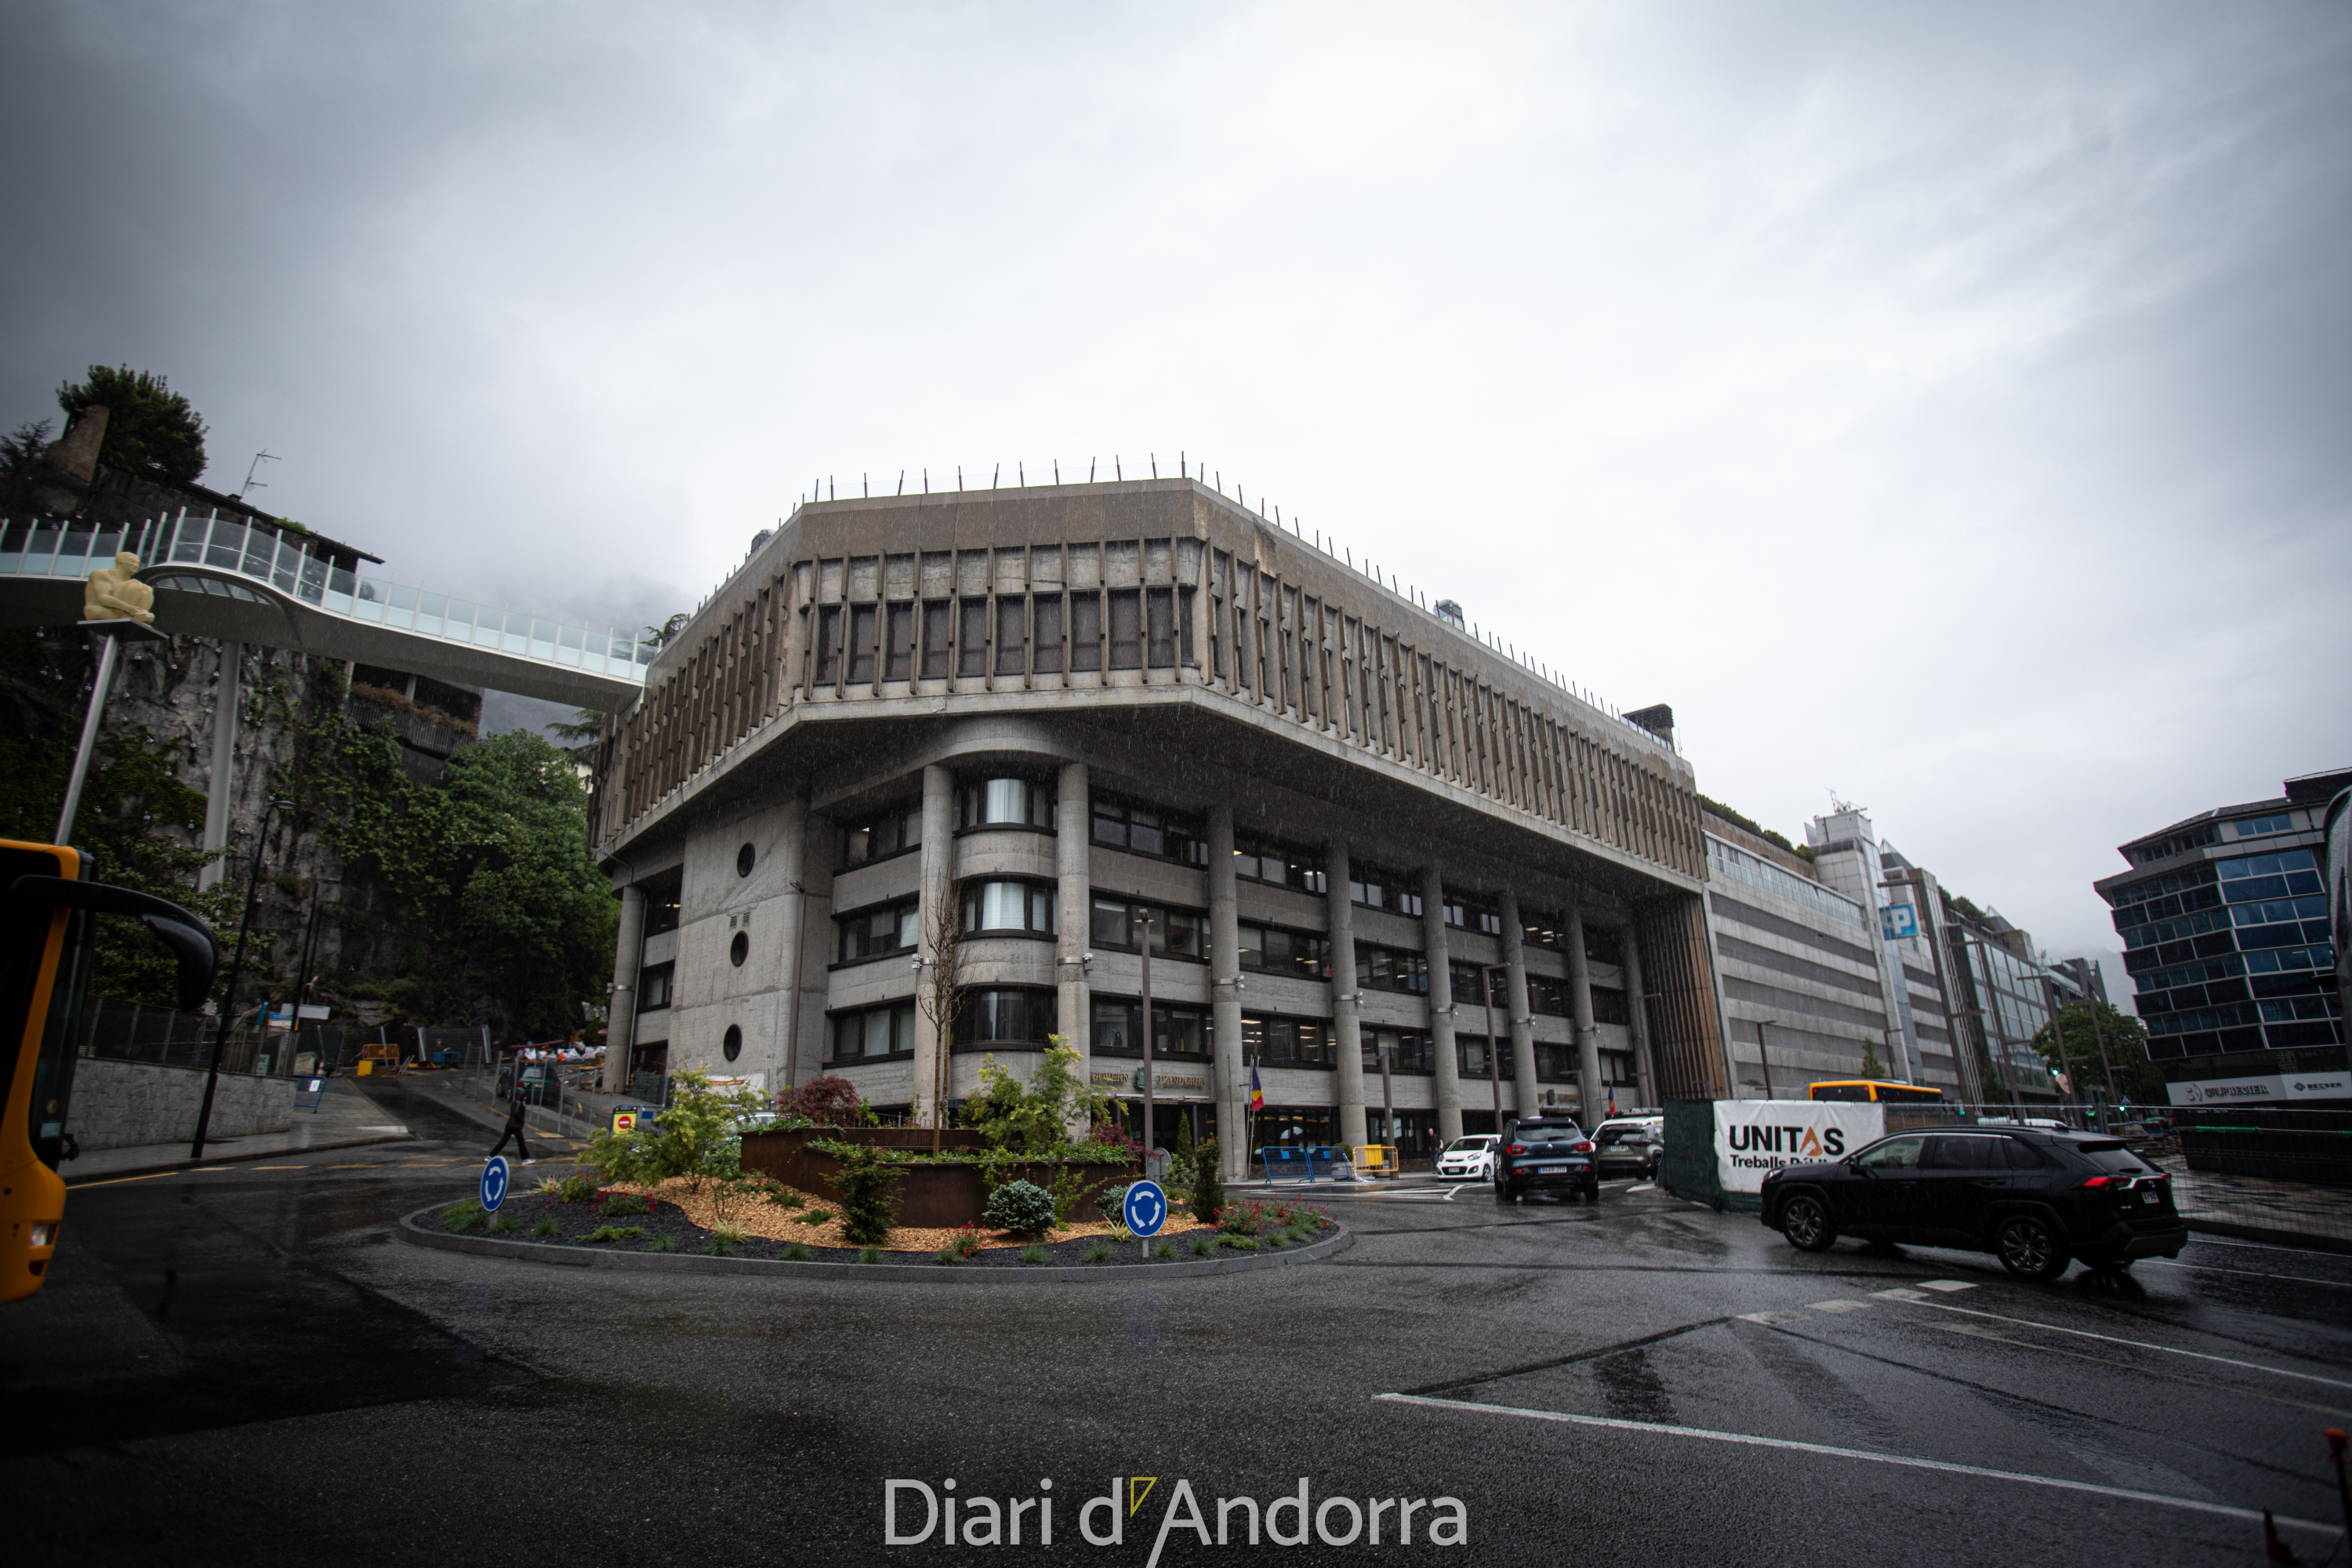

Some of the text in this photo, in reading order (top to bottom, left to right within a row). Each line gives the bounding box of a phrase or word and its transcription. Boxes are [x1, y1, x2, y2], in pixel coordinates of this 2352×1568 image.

[1891, 907, 1912, 934] P
[1091, 1072, 1207, 1086] GOVERN D'ANDORRA
[1730, 1125, 1845, 1156] UNITAS
[1730, 1154, 1787, 1168] Treballs
